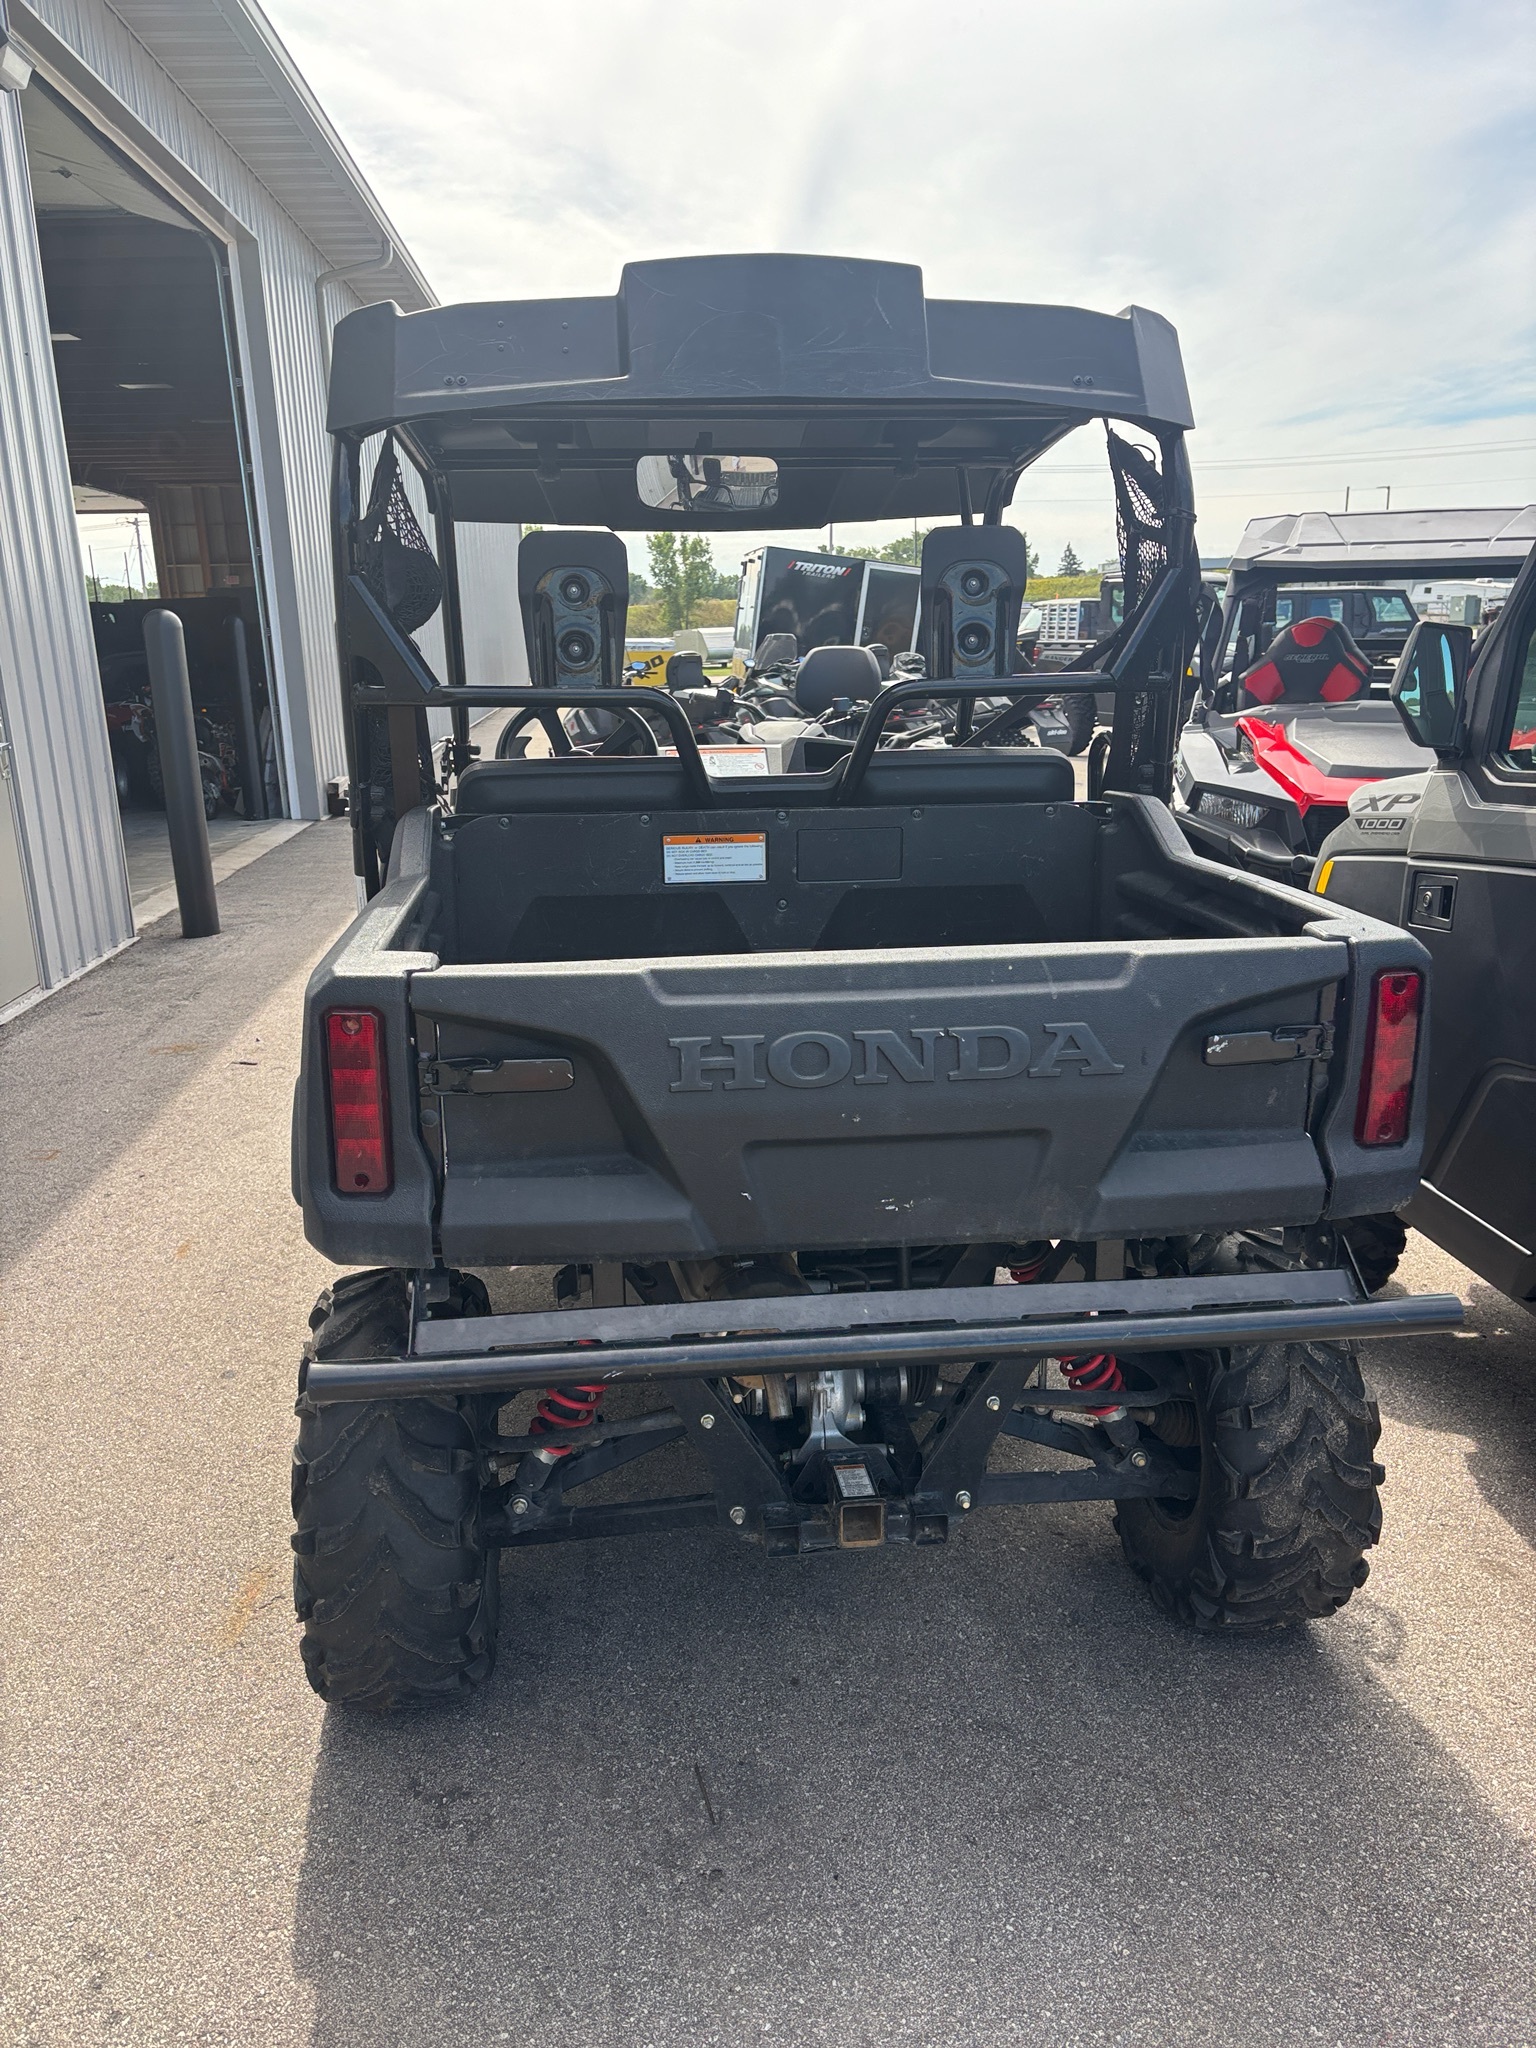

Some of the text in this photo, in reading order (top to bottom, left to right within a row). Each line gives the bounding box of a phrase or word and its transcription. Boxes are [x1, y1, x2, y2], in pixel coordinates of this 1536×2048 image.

[794, 561, 847, 576] TRITON
[802, 571, 836, 579] TRAILERS
[1283, 653, 1330, 661] GENERAL
[1354, 793, 1422, 812] XP
[1360, 819, 1403, 829] 1000
[668, 1022, 1125, 1093] HONDA
